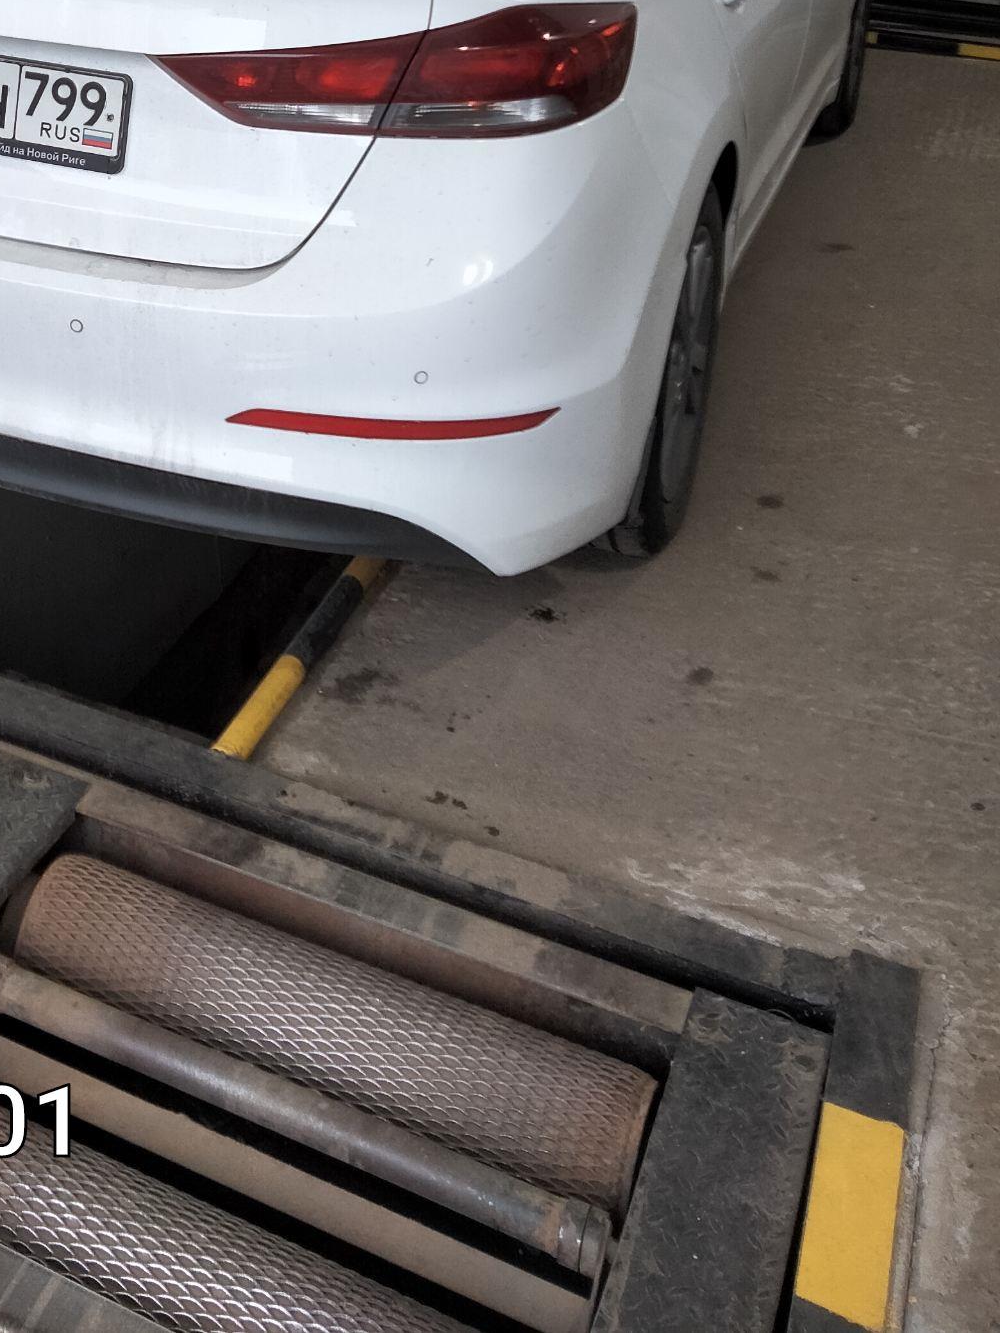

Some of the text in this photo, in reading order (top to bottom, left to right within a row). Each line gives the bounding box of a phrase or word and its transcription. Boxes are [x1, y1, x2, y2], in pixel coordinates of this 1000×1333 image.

[24, 71, 107, 127] 799
[39, 122, 81, 143] RUS
[12, 146, 25, 156] на
[26, 147, 60, 162] Новой
[61, 152, 87, 167] Риге
